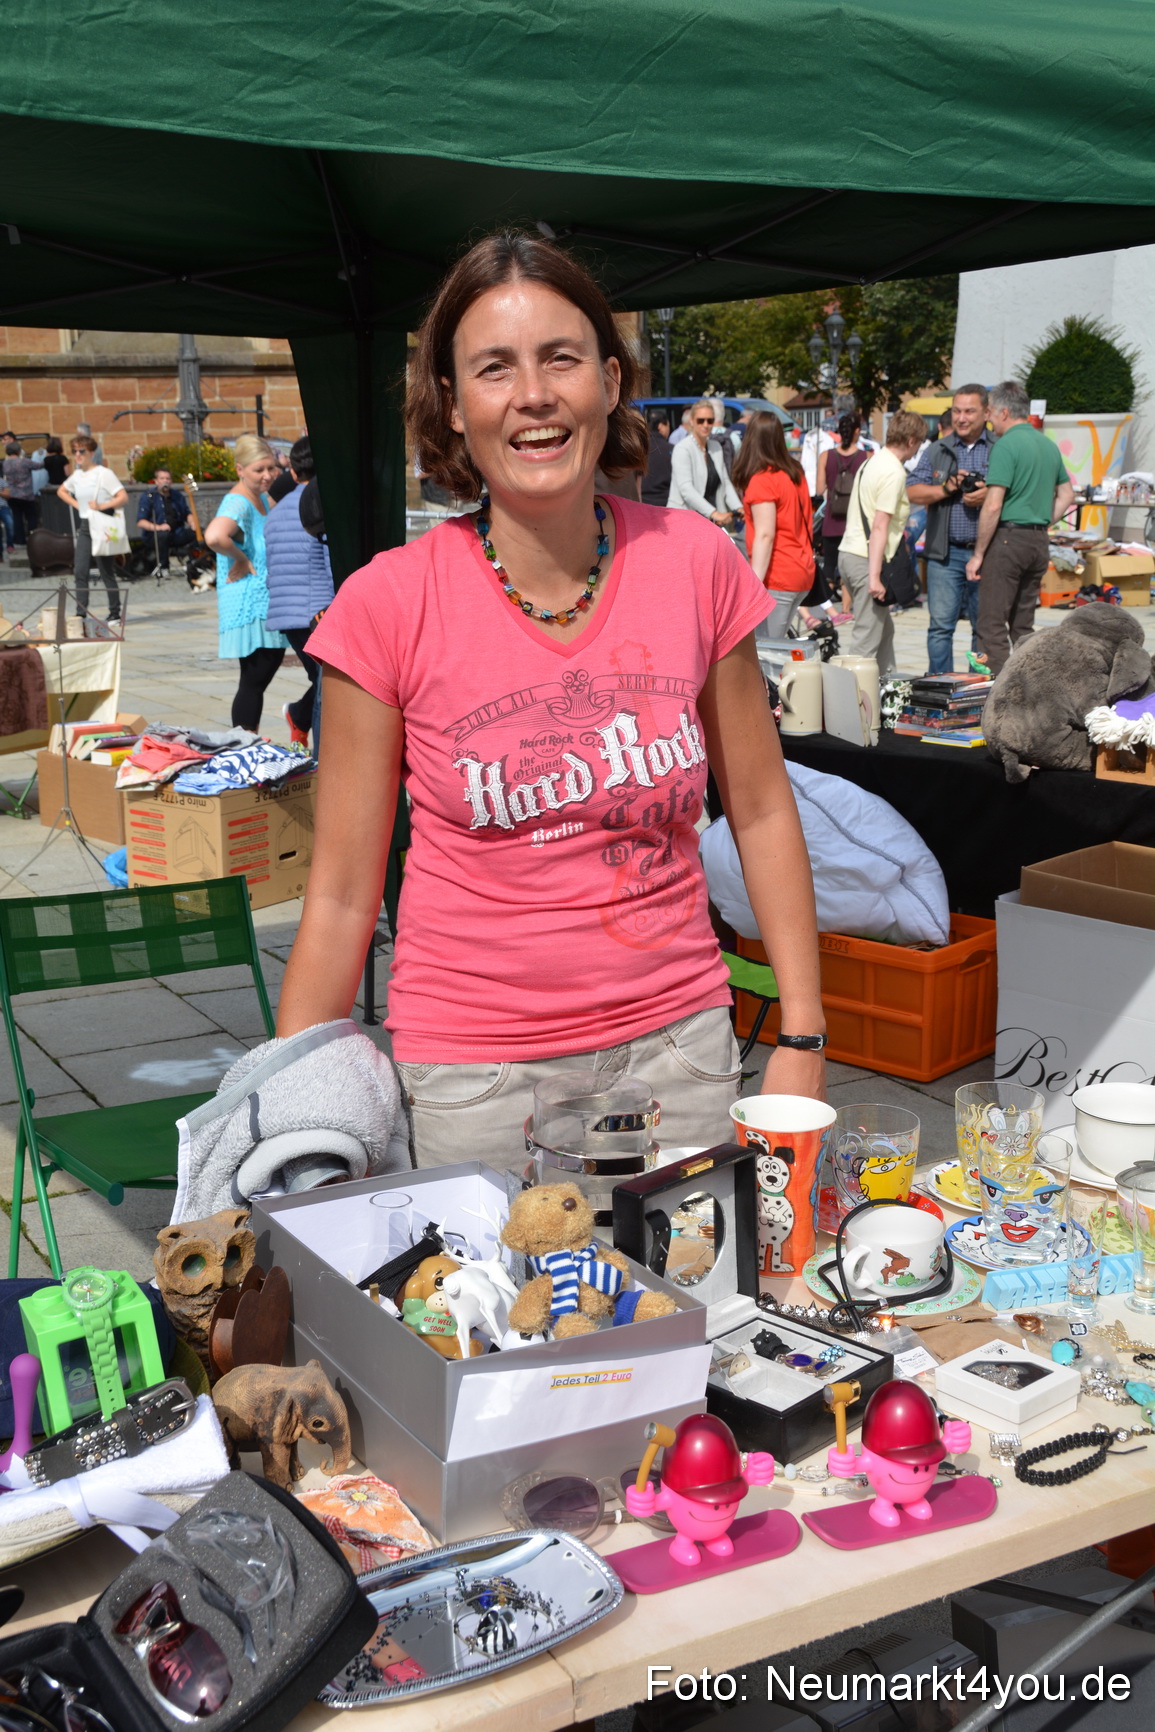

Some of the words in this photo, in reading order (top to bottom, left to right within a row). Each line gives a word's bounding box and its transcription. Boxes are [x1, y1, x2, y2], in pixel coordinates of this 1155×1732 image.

[469, 698, 504, 728] LOVE
[511, 689, 538, 710] ALL
[617, 676, 658, 690] SERVE
[663, 678, 686, 696] ALL
[519, 735, 548, 750] Hard
[548, 733, 574, 746] Rock
[513, 757, 563, 782] Original
[519, 756, 535, 768] the
[453, 752, 593, 831] Hard
[595, 712, 706, 789] Rock
[531, 822, 584, 848] Berlin
[818, 934, 850, 953] BI
[429, 1325, 445, 1333] SOON
[437, 1318, 453, 1327] WELL
[551, 1376, 581, 1387] Jedes
[584, 1374, 601, 1385] Teil
[602, 1373, 608, 1382] 2
[611, 1371, 632, 1382] Euro
